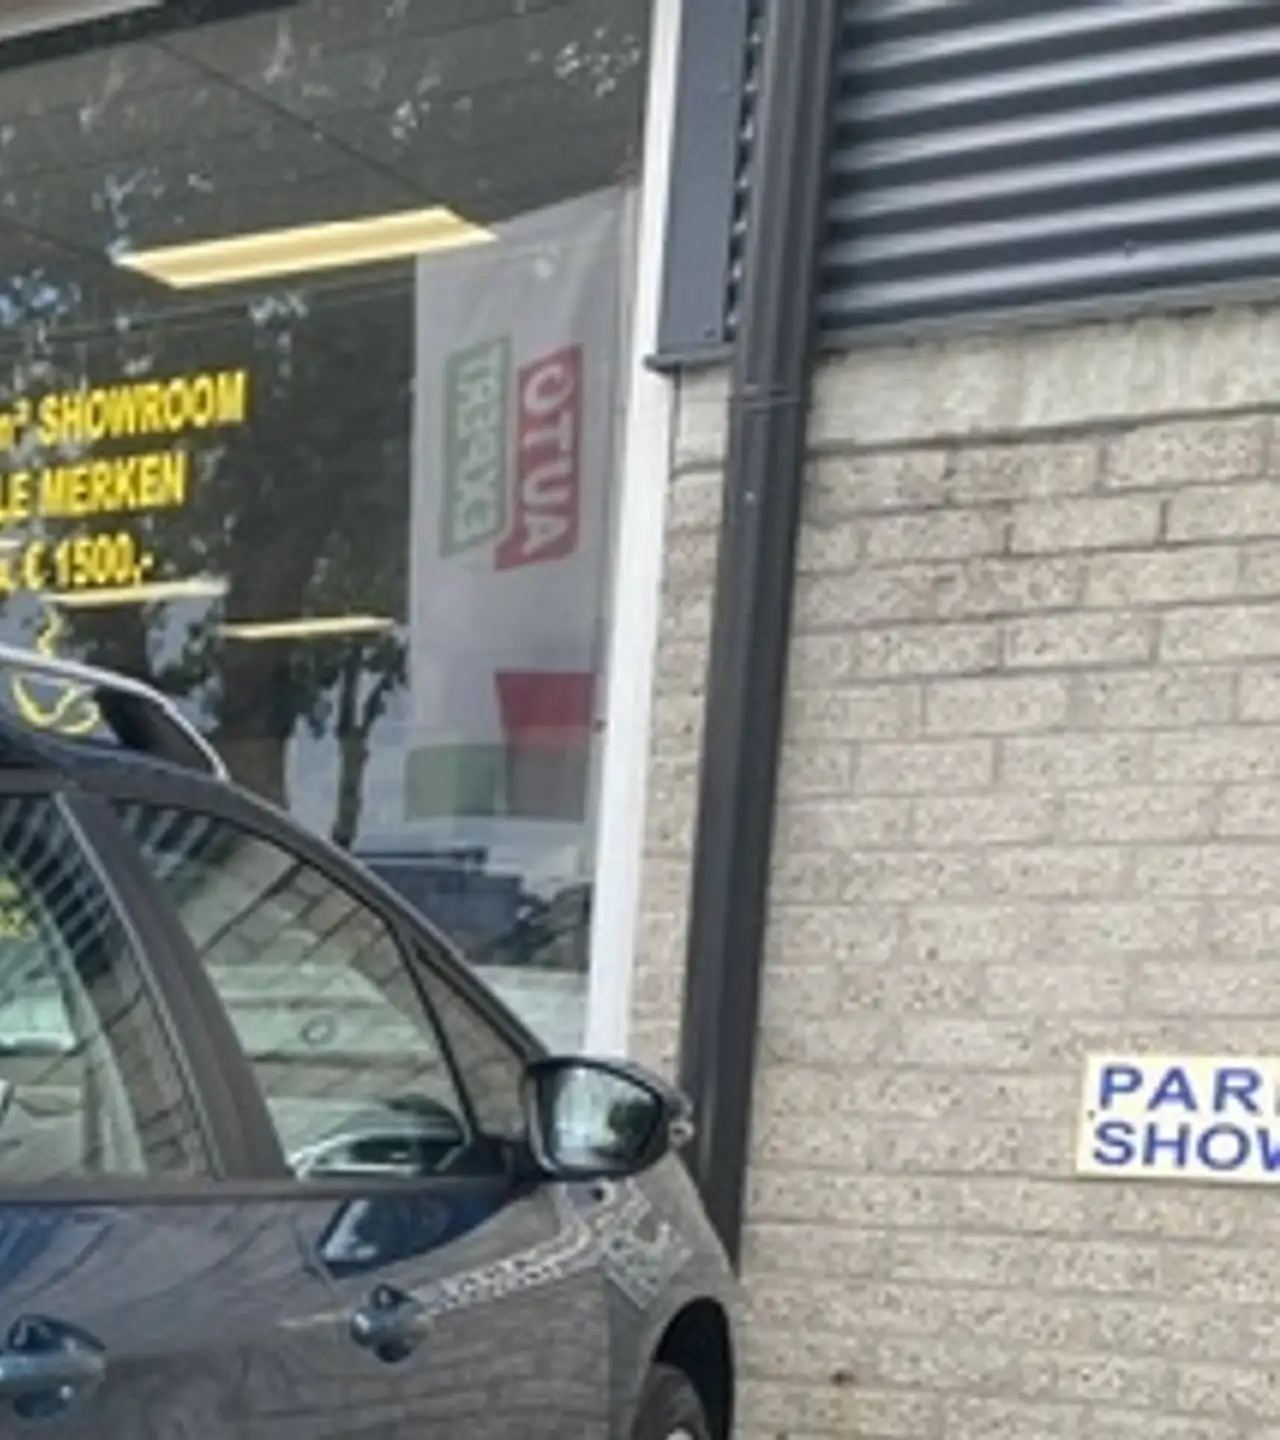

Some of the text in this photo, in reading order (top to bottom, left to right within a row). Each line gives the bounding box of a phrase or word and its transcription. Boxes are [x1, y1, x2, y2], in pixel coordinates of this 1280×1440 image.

[37, 369, 246, 447] SHOWROOM
[38, 449, 186, 518] MERKEN
[1099, 1063, 1280, 1116] PAR
